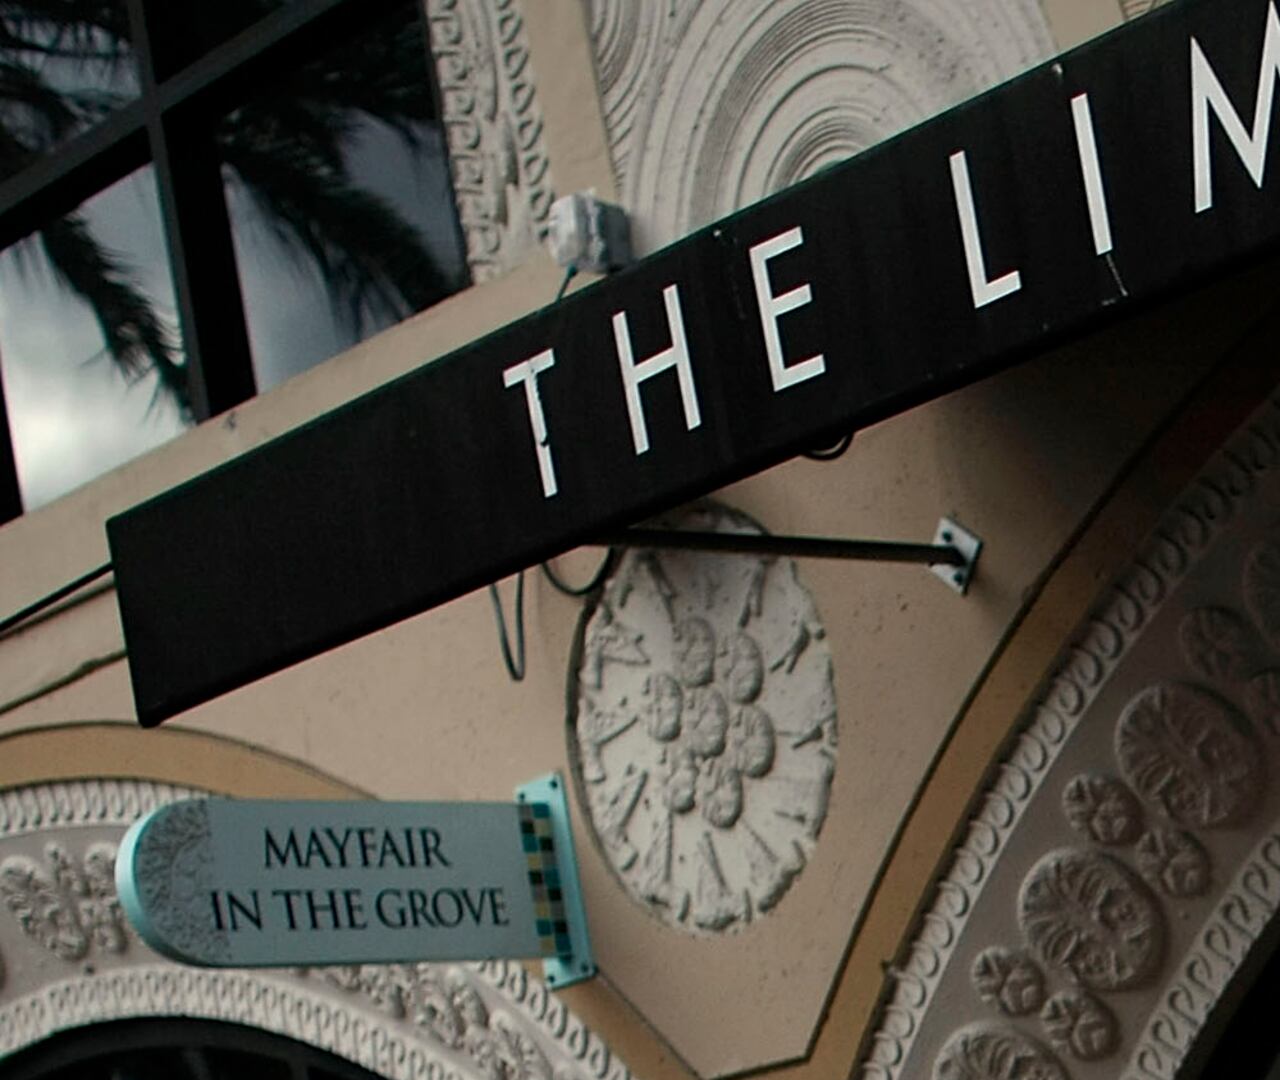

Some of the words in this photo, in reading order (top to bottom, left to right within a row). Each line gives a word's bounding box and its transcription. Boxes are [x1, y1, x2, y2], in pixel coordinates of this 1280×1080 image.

[502, 225, 827, 499] THE
[263, 826, 452, 868] MAYFAIR
[210, 891, 263, 931] IN
[271, 889, 368, 930] THE
[375, 886, 510, 929] GROVE
